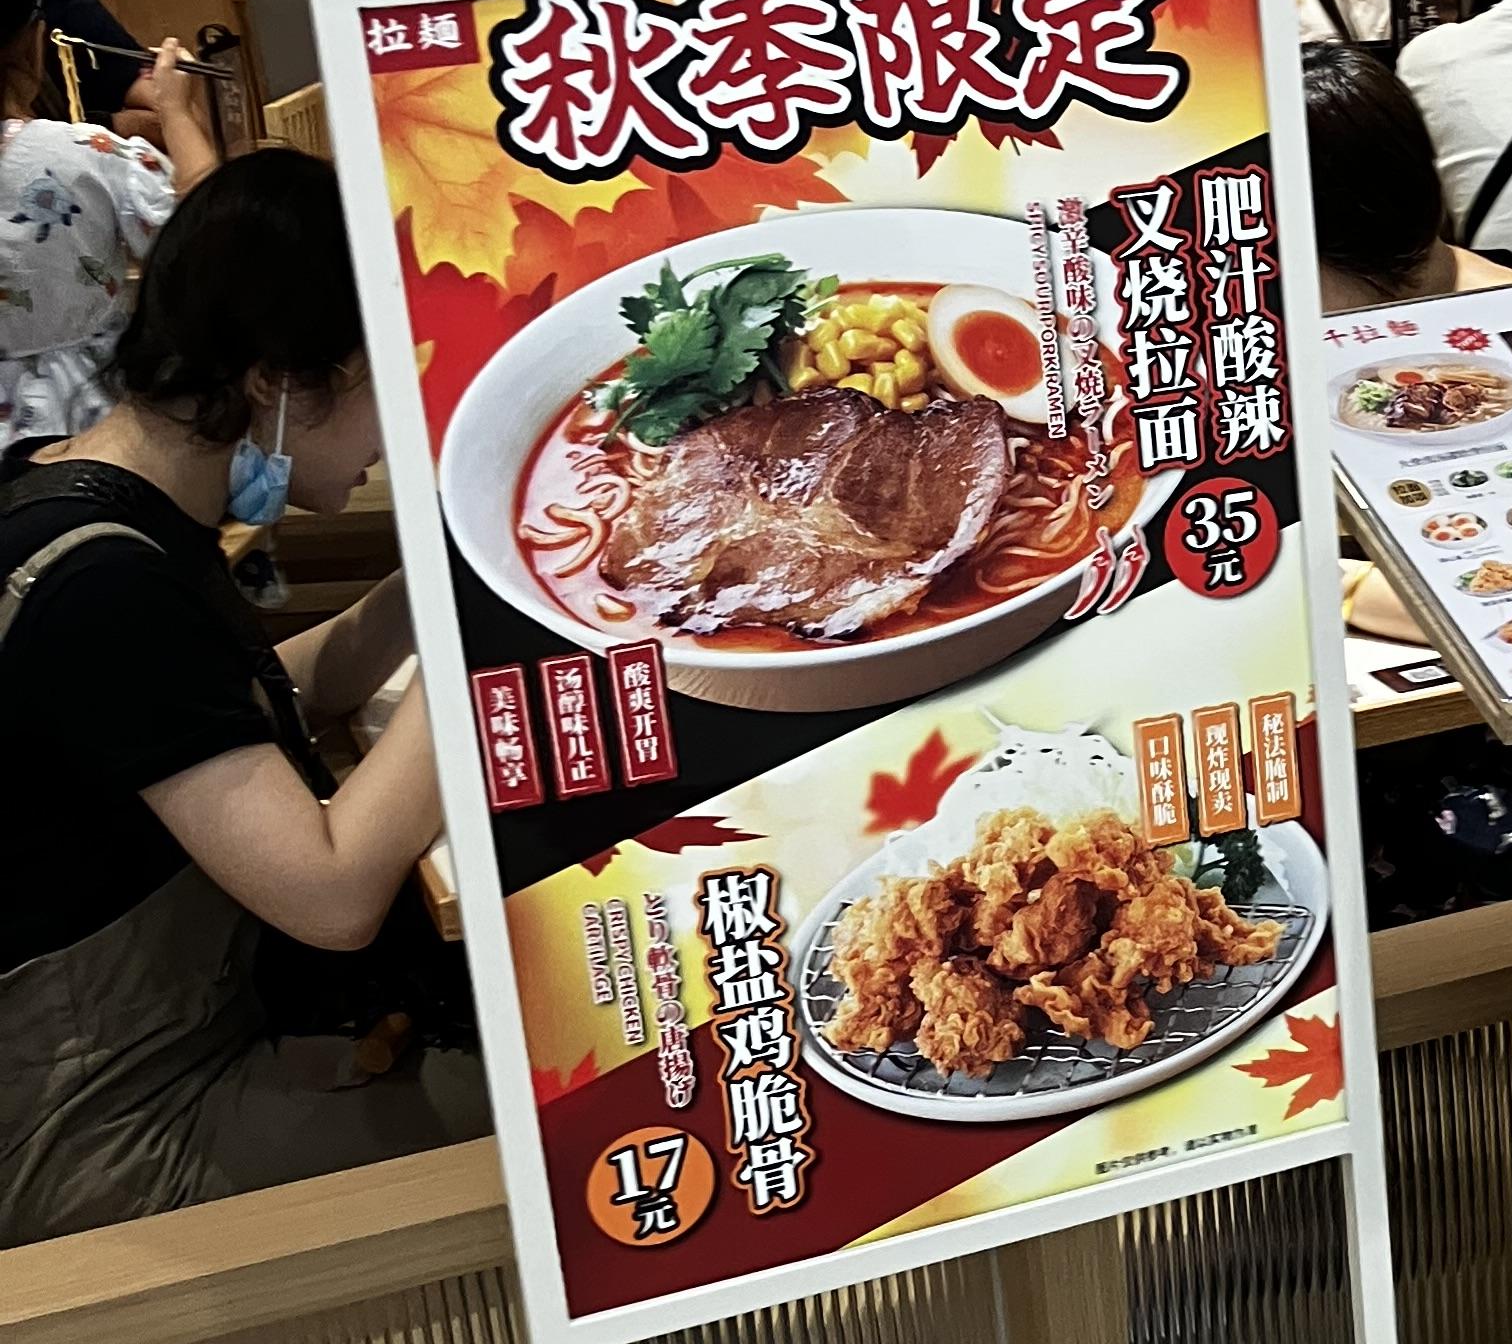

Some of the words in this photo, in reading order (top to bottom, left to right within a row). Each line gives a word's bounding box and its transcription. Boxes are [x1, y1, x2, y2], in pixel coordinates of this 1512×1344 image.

[1025, 201, 1047, 254] SPICY
[1031, 258, 1055, 310] SOUR
[1201, 174, 1284, 459] 肥汁酸辣
[1039, 311, 1061, 370] PORK
[1122, 184, 1201, 469] 叉烧拉面
[1045, 370, 1067, 439] RAMEN
[1184, 486, 1258, 549] 35
[1206, 550, 1243, 586] 元
[490, 686, 528, 788] 美味畅享
[554, 667, 596, 781] 汤醇味儿正
[623, 661, 659, 763] 酸爽开胃
[1149, 735, 1176, 827] 口味酥脆
[1205, 722, 1233, 816] 现炸现卖
[1262, 713, 1289, 804] 秘法腌制
[605, 898, 633, 961] CRISPY
[617, 962, 644, 1045] CHICKEN
[704, 870, 810, 1211] 椒盐鸡脆骨
[610, 1136, 686, 1203] 17
[634, 1198, 677, 1234] 元
